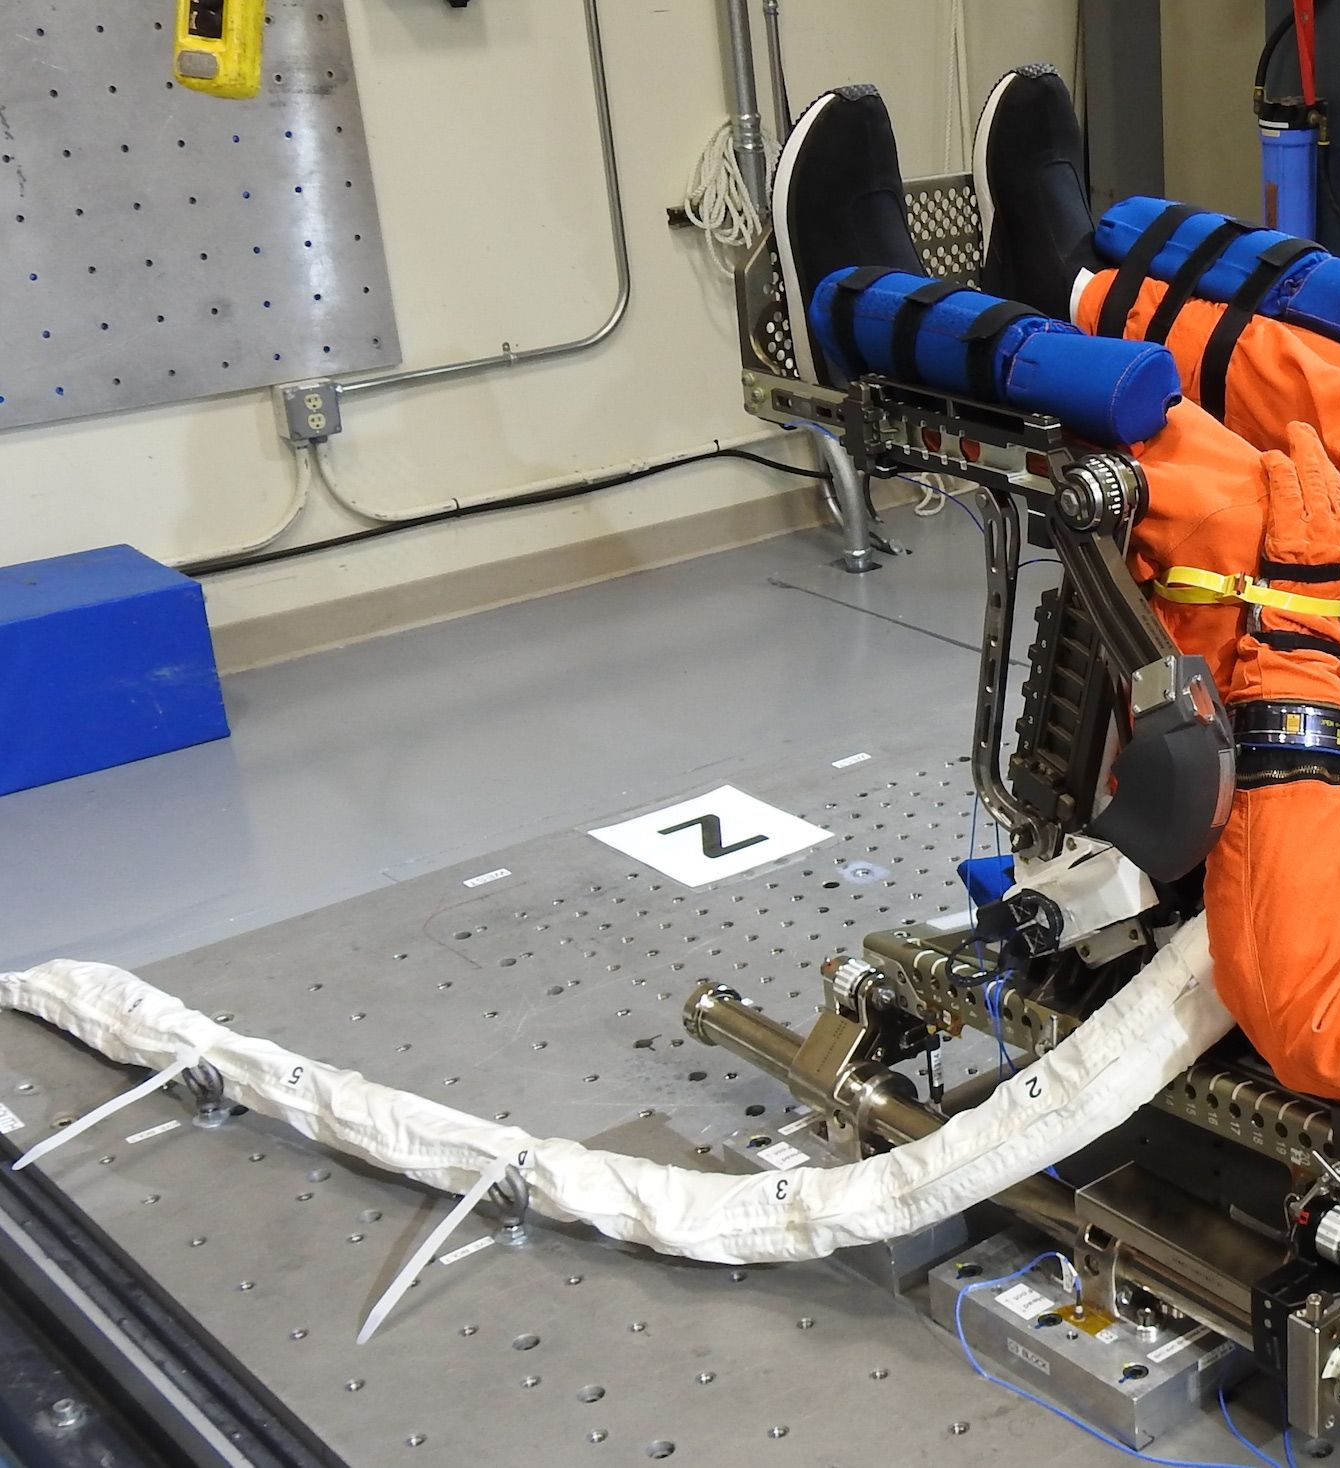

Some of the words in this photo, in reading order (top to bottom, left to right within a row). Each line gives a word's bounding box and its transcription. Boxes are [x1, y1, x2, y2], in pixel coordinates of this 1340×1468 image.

[288, 1066, 304, 1085] 5
[1025, 1076, 1042, 1098] 2
[1230, 1121, 1241, 1137] 17
[776, 1179, 788, 1200] 3
